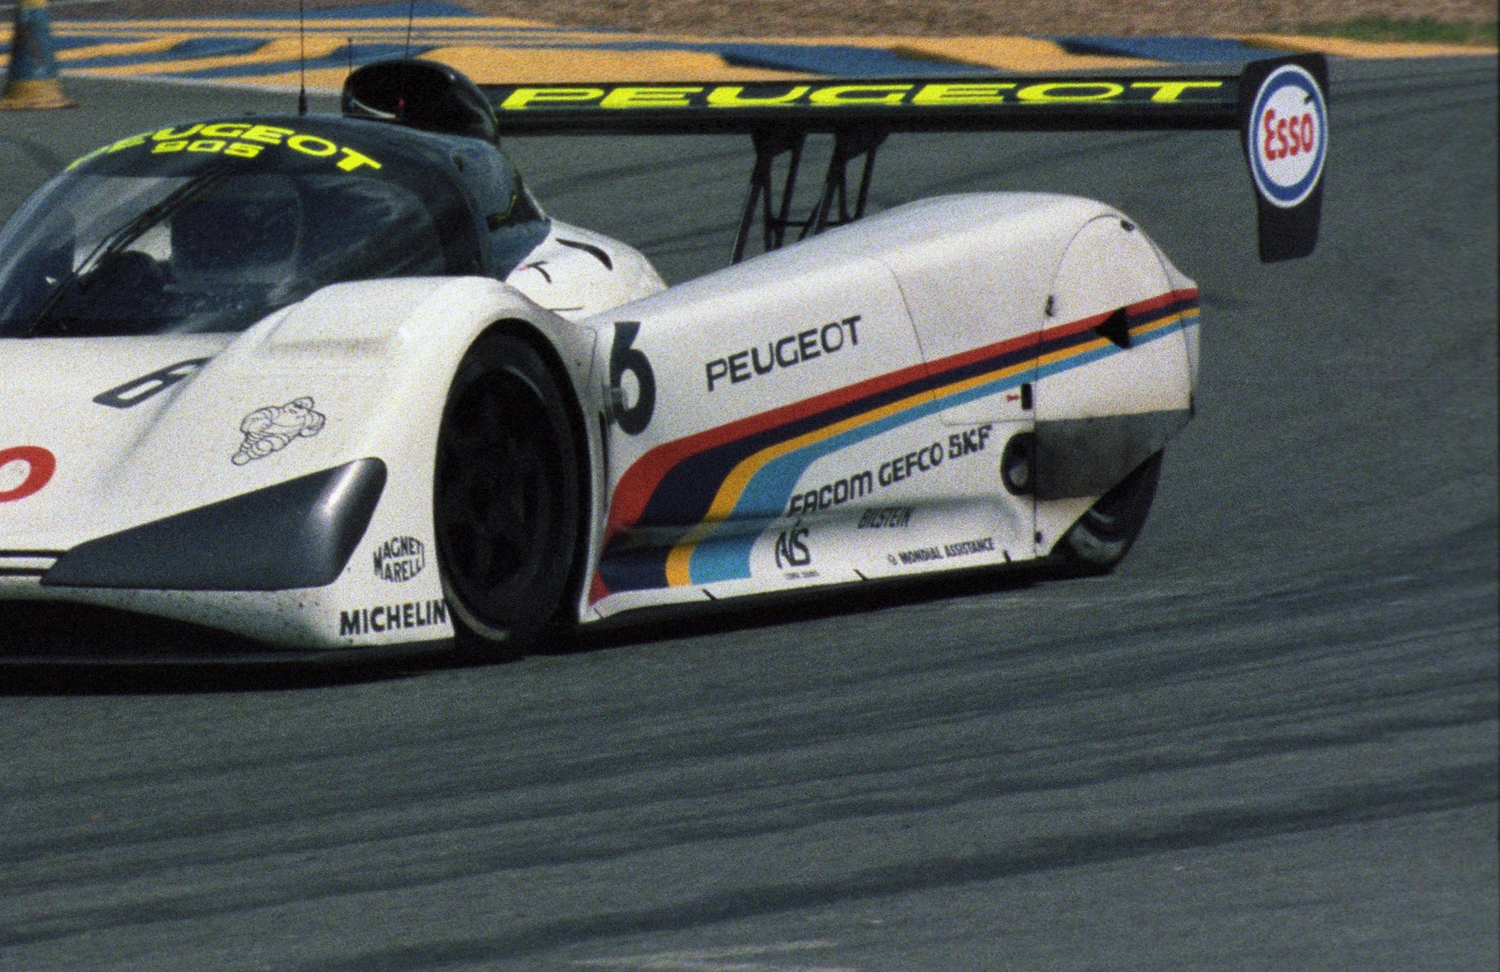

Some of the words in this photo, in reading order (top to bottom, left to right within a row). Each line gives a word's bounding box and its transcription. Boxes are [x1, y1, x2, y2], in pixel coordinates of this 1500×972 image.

[501, 81, 1223, 110] PEUGEOT
[152, 139, 264, 158] 905
[609, 320, 657, 437] 6
[705, 315, 863, 393] PEUGEOT
[785, 470, 874, 518] FACOM
[879, 441, 944, 487] GEFCO
[949, 424, 993, 459] SKF
[340, 598, 448, 636] MICHELIN
